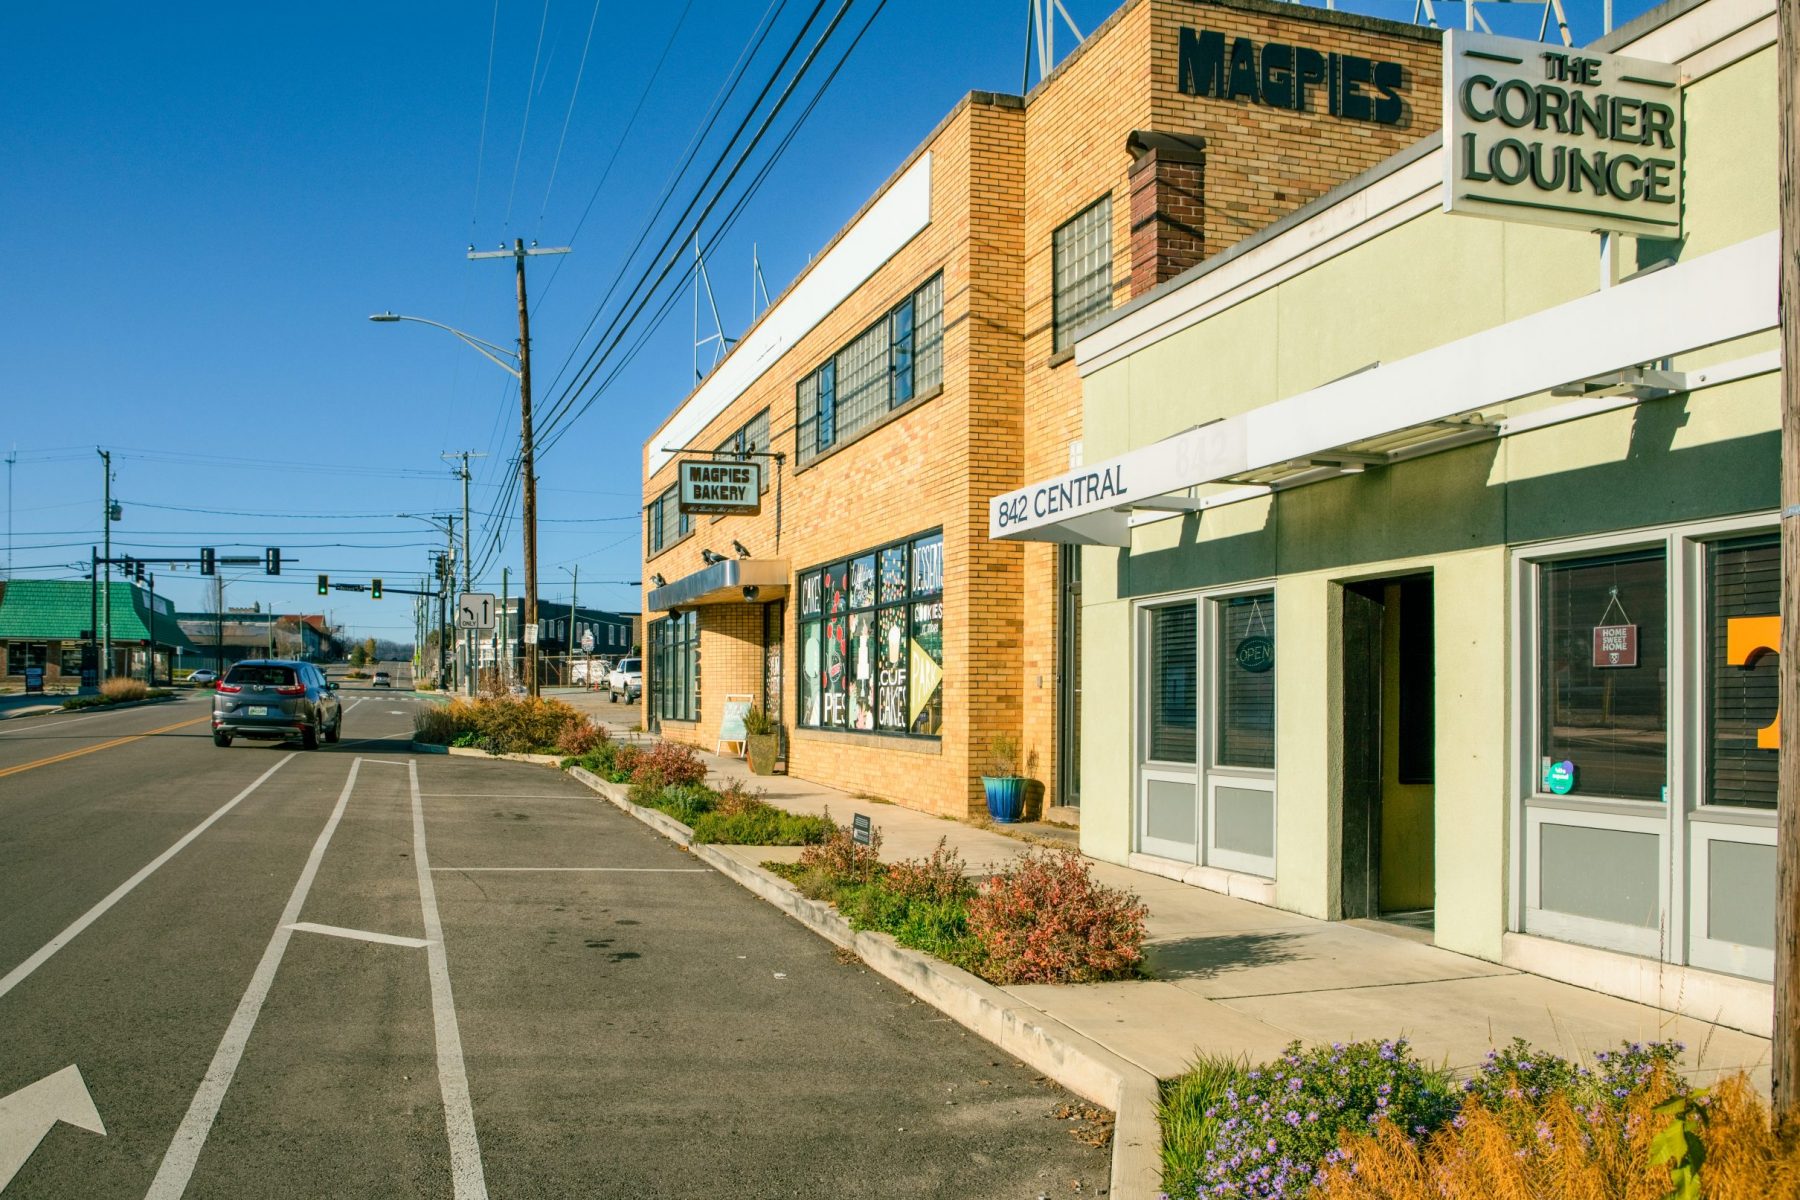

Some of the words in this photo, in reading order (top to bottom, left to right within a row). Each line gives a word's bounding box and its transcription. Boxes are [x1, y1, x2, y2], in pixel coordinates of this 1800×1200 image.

[1178, 26, 1403, 125] MAGPIES
[1540, 51, 1602, 87] THE
[1461, 74, 1676, 149] CORNER
[1462, 132, 1676, 205] LOUNGE
[689, 466, 750, 483] MAGPIES
[693, 484, 746, 500] BAKERY
[998, 494, 1028, 528] 842
[1033, 464, 1128, 518] CENTRAL
[914, 603, 943, 622] COOKIES
[1602, 628, 1627, 637] HOME
[1602, 636, 1627, 644] SWEET
[1240, 645, 1270, 661] OPEN
[1602, 643, 1628, 651] HOME
[913, 650, 936, 710] PARK
